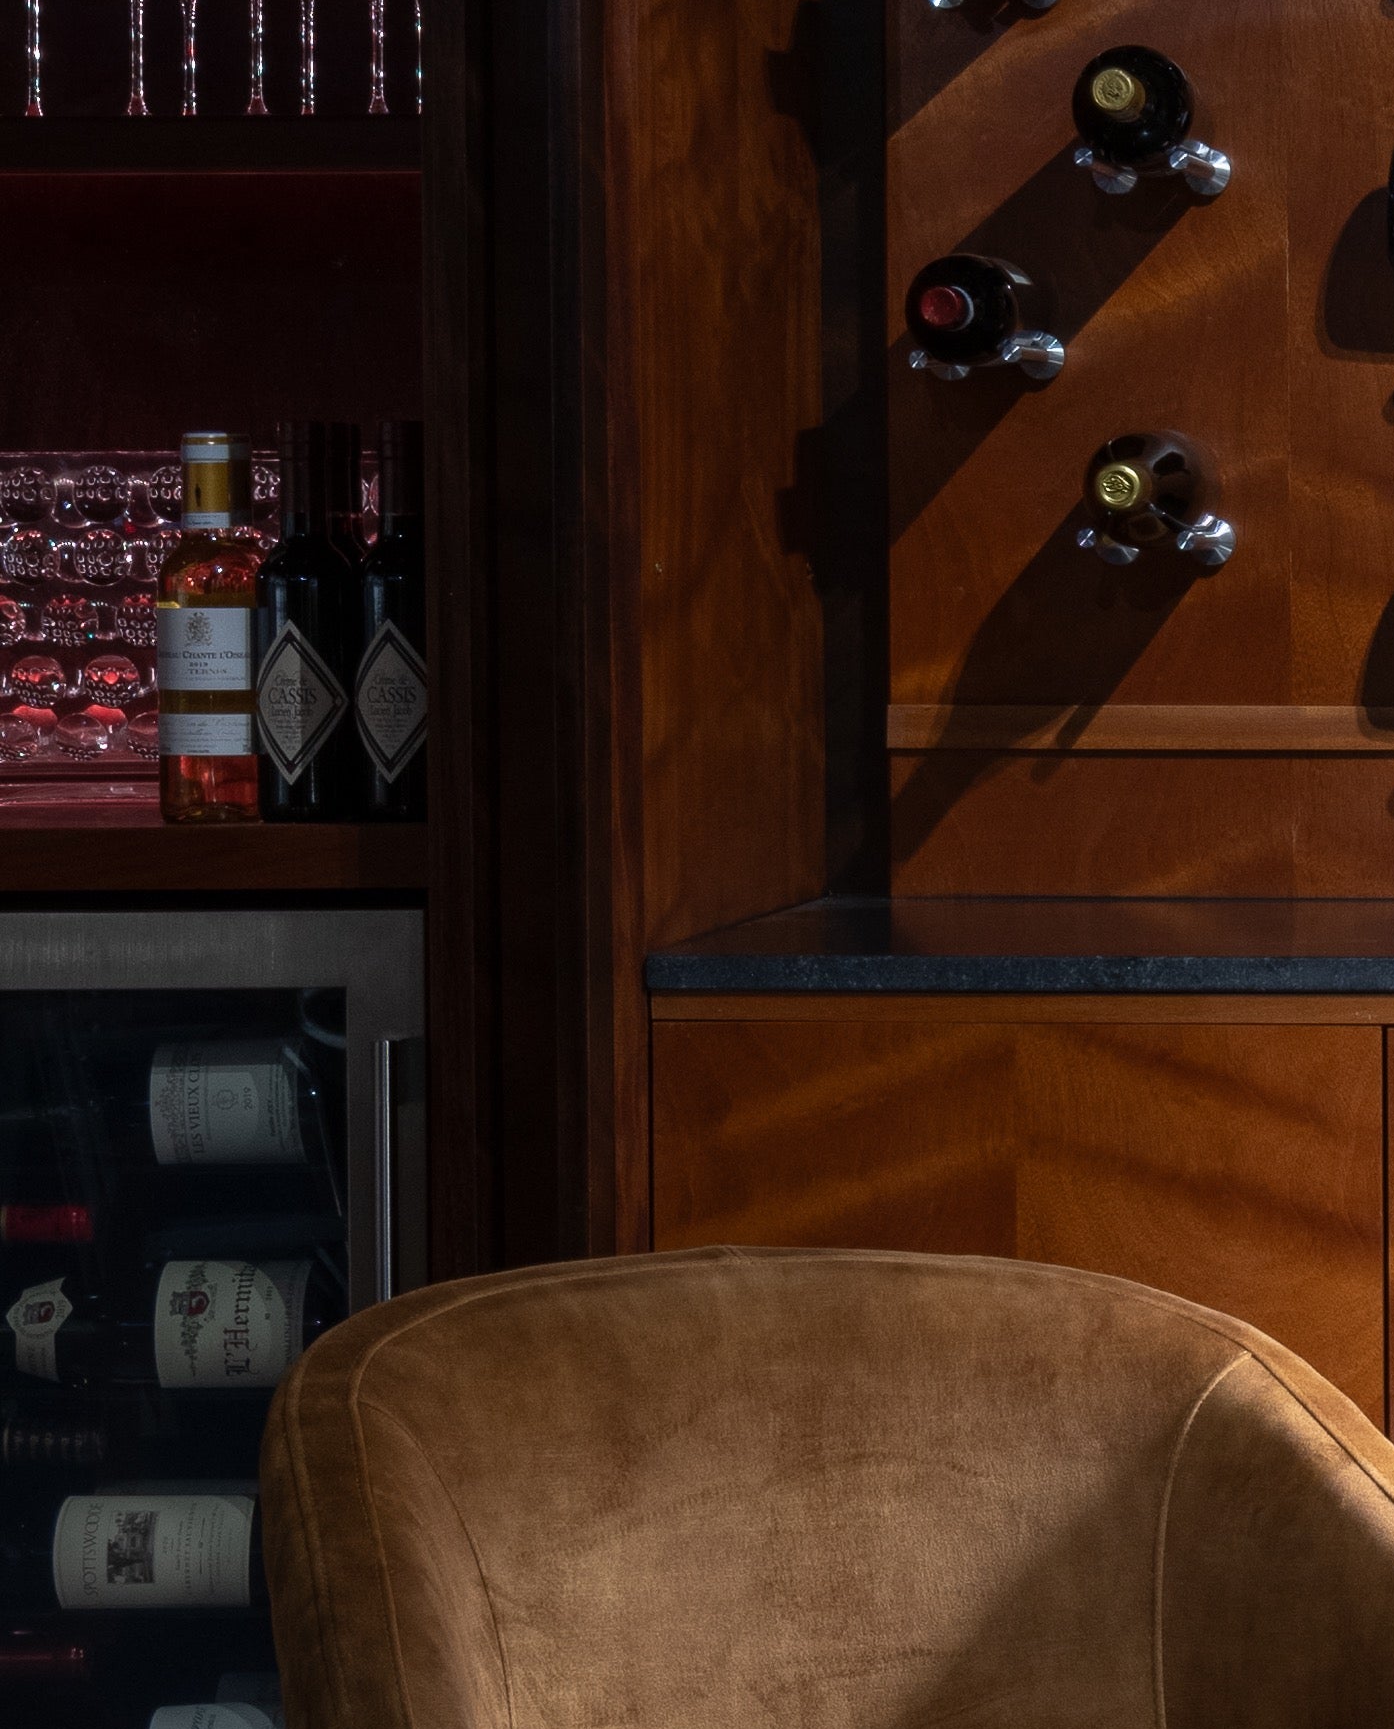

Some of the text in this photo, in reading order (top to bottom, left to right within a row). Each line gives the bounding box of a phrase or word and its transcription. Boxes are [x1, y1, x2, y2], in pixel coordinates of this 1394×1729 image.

[268, 687, 317, 704] CASSIS
[367, 686, 417, 704] CASSIS
[187, 1085, 202, 1131] VIEUX
[243, 1086, 253, 1111] 2019
[223, 1263, 259, 1377] L'Hermita
[81, 1502, 104, 1597] SPOTTSWOODE
